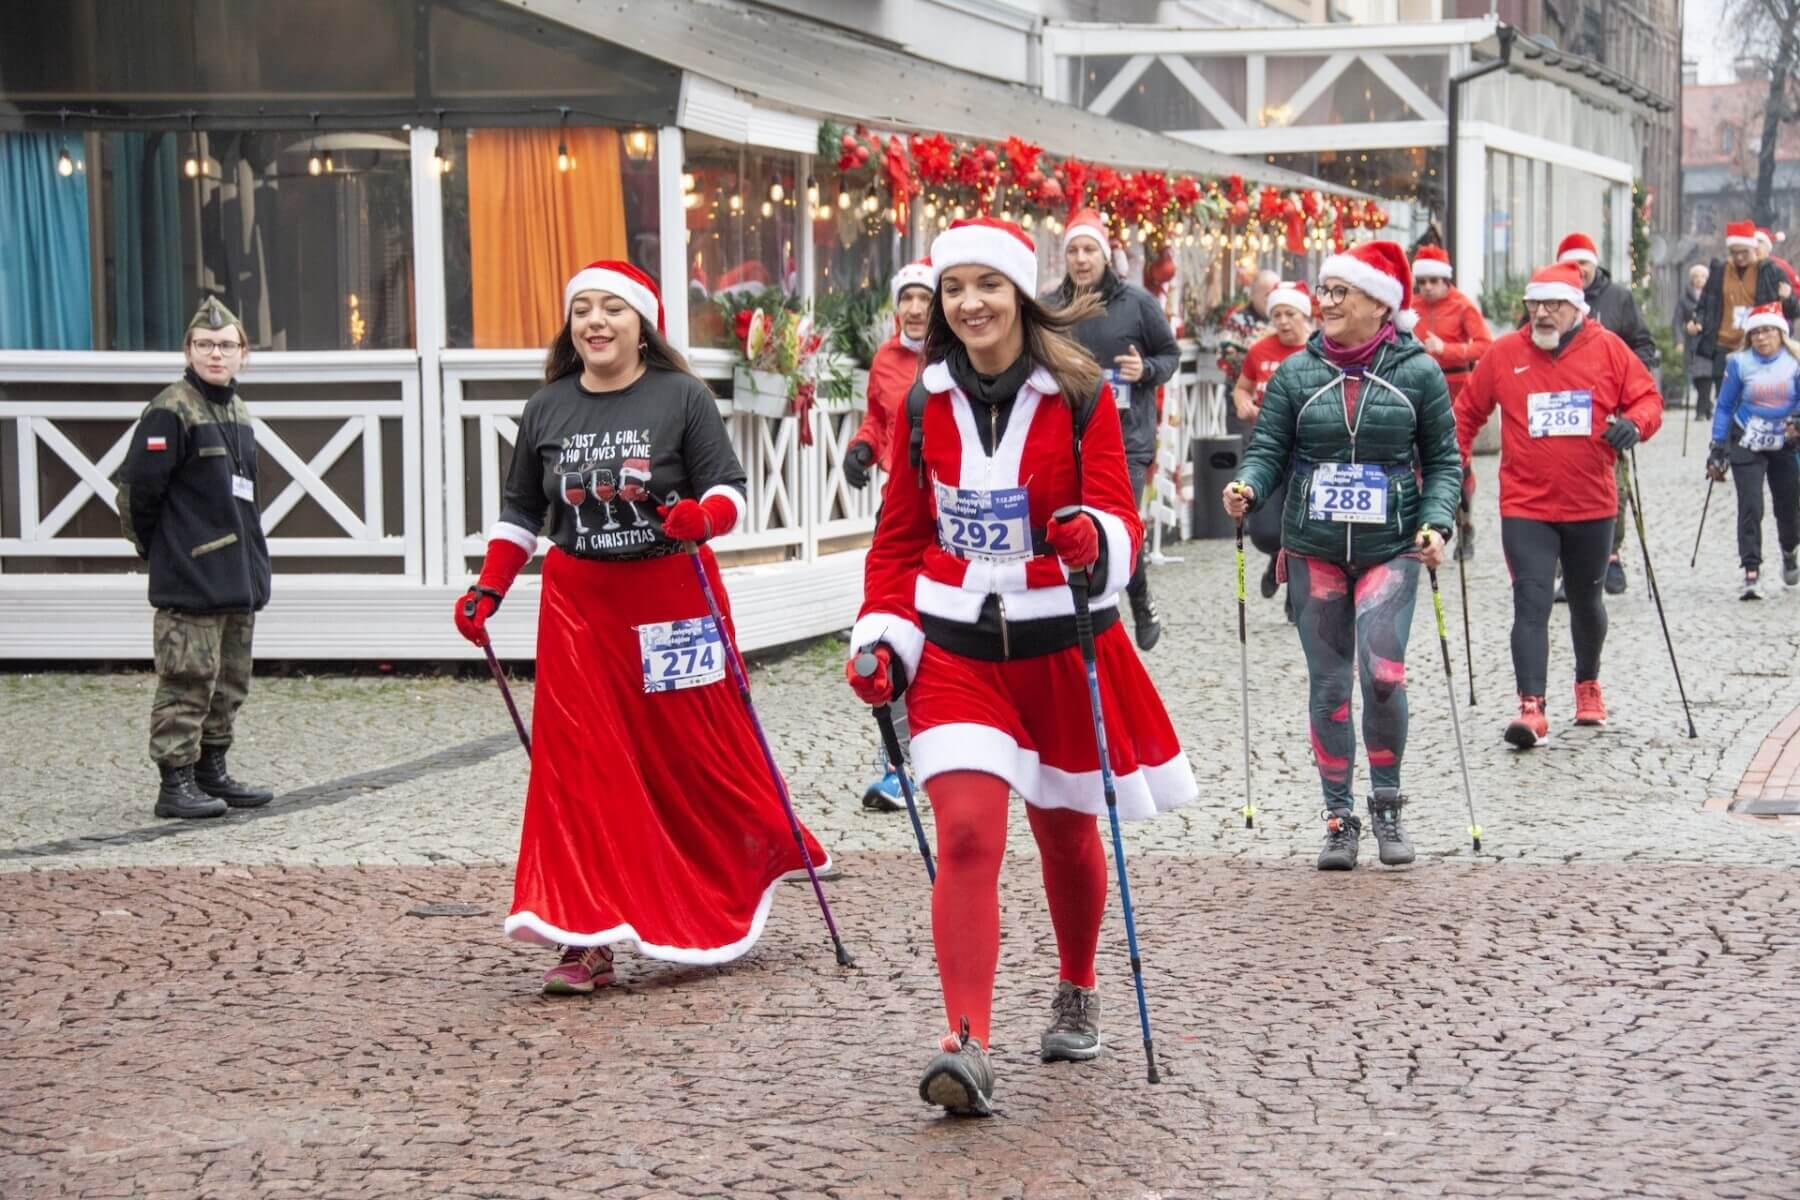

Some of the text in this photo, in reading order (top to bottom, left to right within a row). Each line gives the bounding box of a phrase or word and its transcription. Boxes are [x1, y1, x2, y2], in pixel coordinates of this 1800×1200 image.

[1541, 410, 1580, 427] 286
[569, 429, 641, 449] JUST A GIRL
[584, 445, 616, 462] LOVES
[621, 443, 651, 458] WINE
[1324, 489, 1372, 511] 288
[591, 529, 656, 550] CHRISTMAS
[949, 518, 1011, 551] 292
[661, 645, 715, 678] 274
